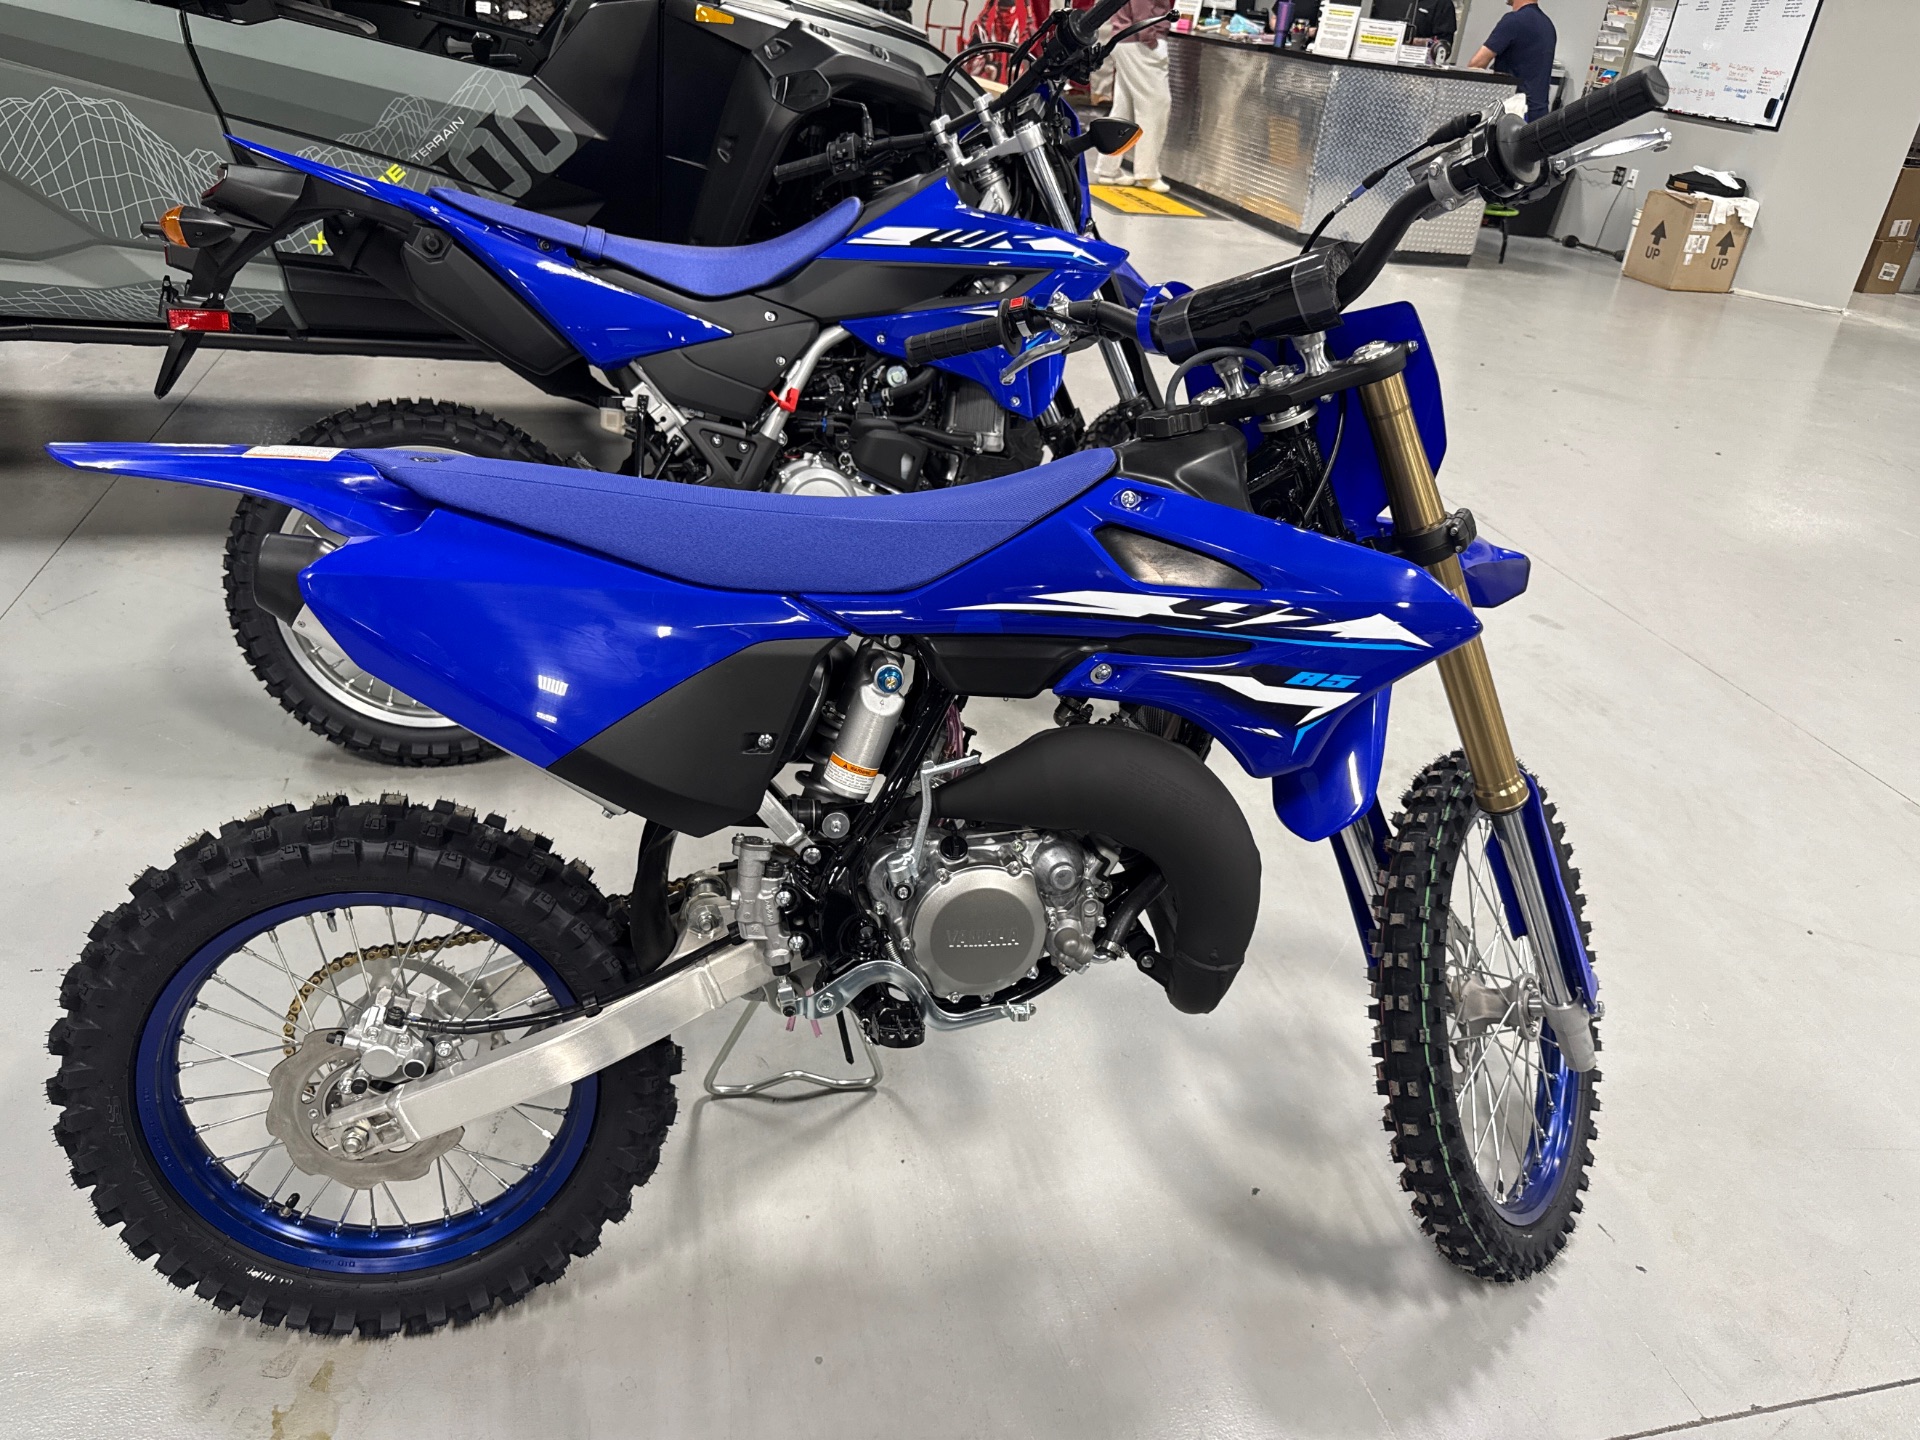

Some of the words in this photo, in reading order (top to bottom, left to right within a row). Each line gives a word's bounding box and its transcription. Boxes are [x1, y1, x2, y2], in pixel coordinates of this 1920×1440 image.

[411, 116, 465, 162] TERRAIN
[1644, 245, 1660, 260] UP
[1710, 257, 1729, 271] UP
[1284, 671, 1362, 689] 85
